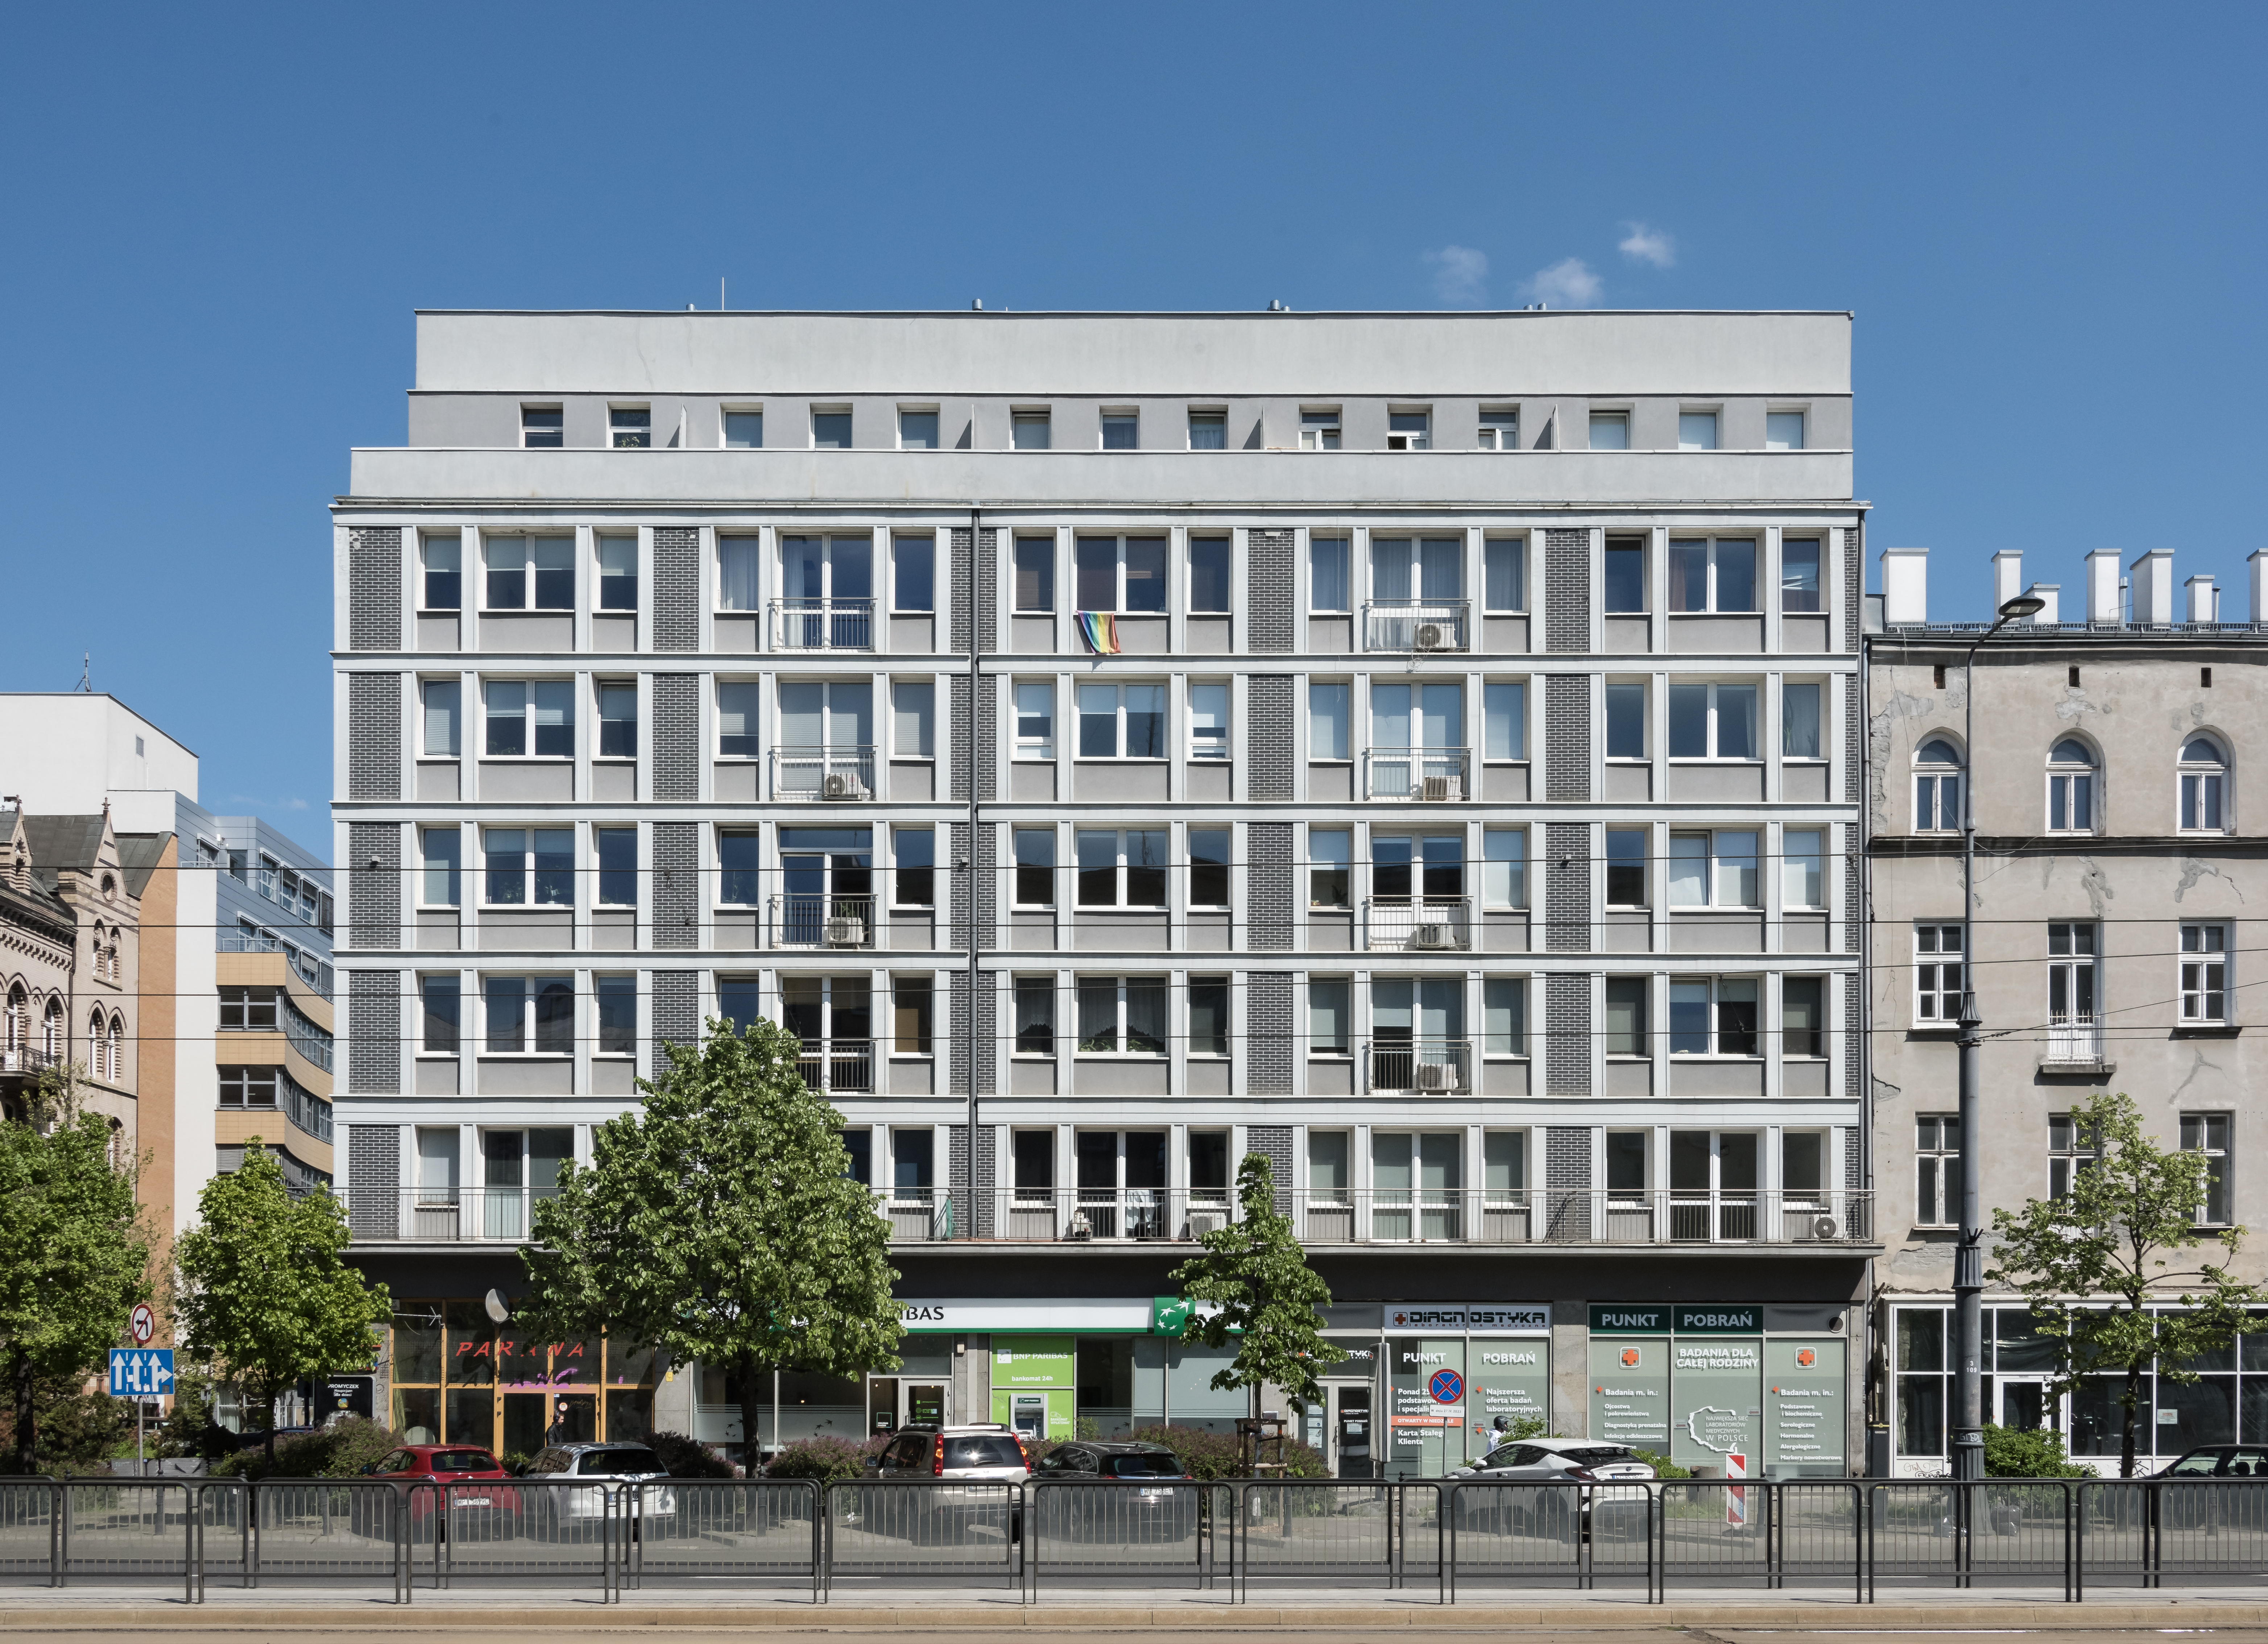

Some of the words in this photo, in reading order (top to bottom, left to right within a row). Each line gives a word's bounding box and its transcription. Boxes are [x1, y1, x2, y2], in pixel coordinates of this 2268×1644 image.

[1410, 1311, 1545, 1323] DIAGNOSTYKA
[1602, 1314, 1658, 1326] PUNKT
[1684, 1311, 1752, 1326] POBRAŃ
[1403, 1353, 1446, 1362] PUNKT
[1483, 1350, 1536, 1363] POBRAŃ
[1676, 1358, 1706, 1369] CAŁEJ
[1710, 1358, 1759, 1367] RODZINY
